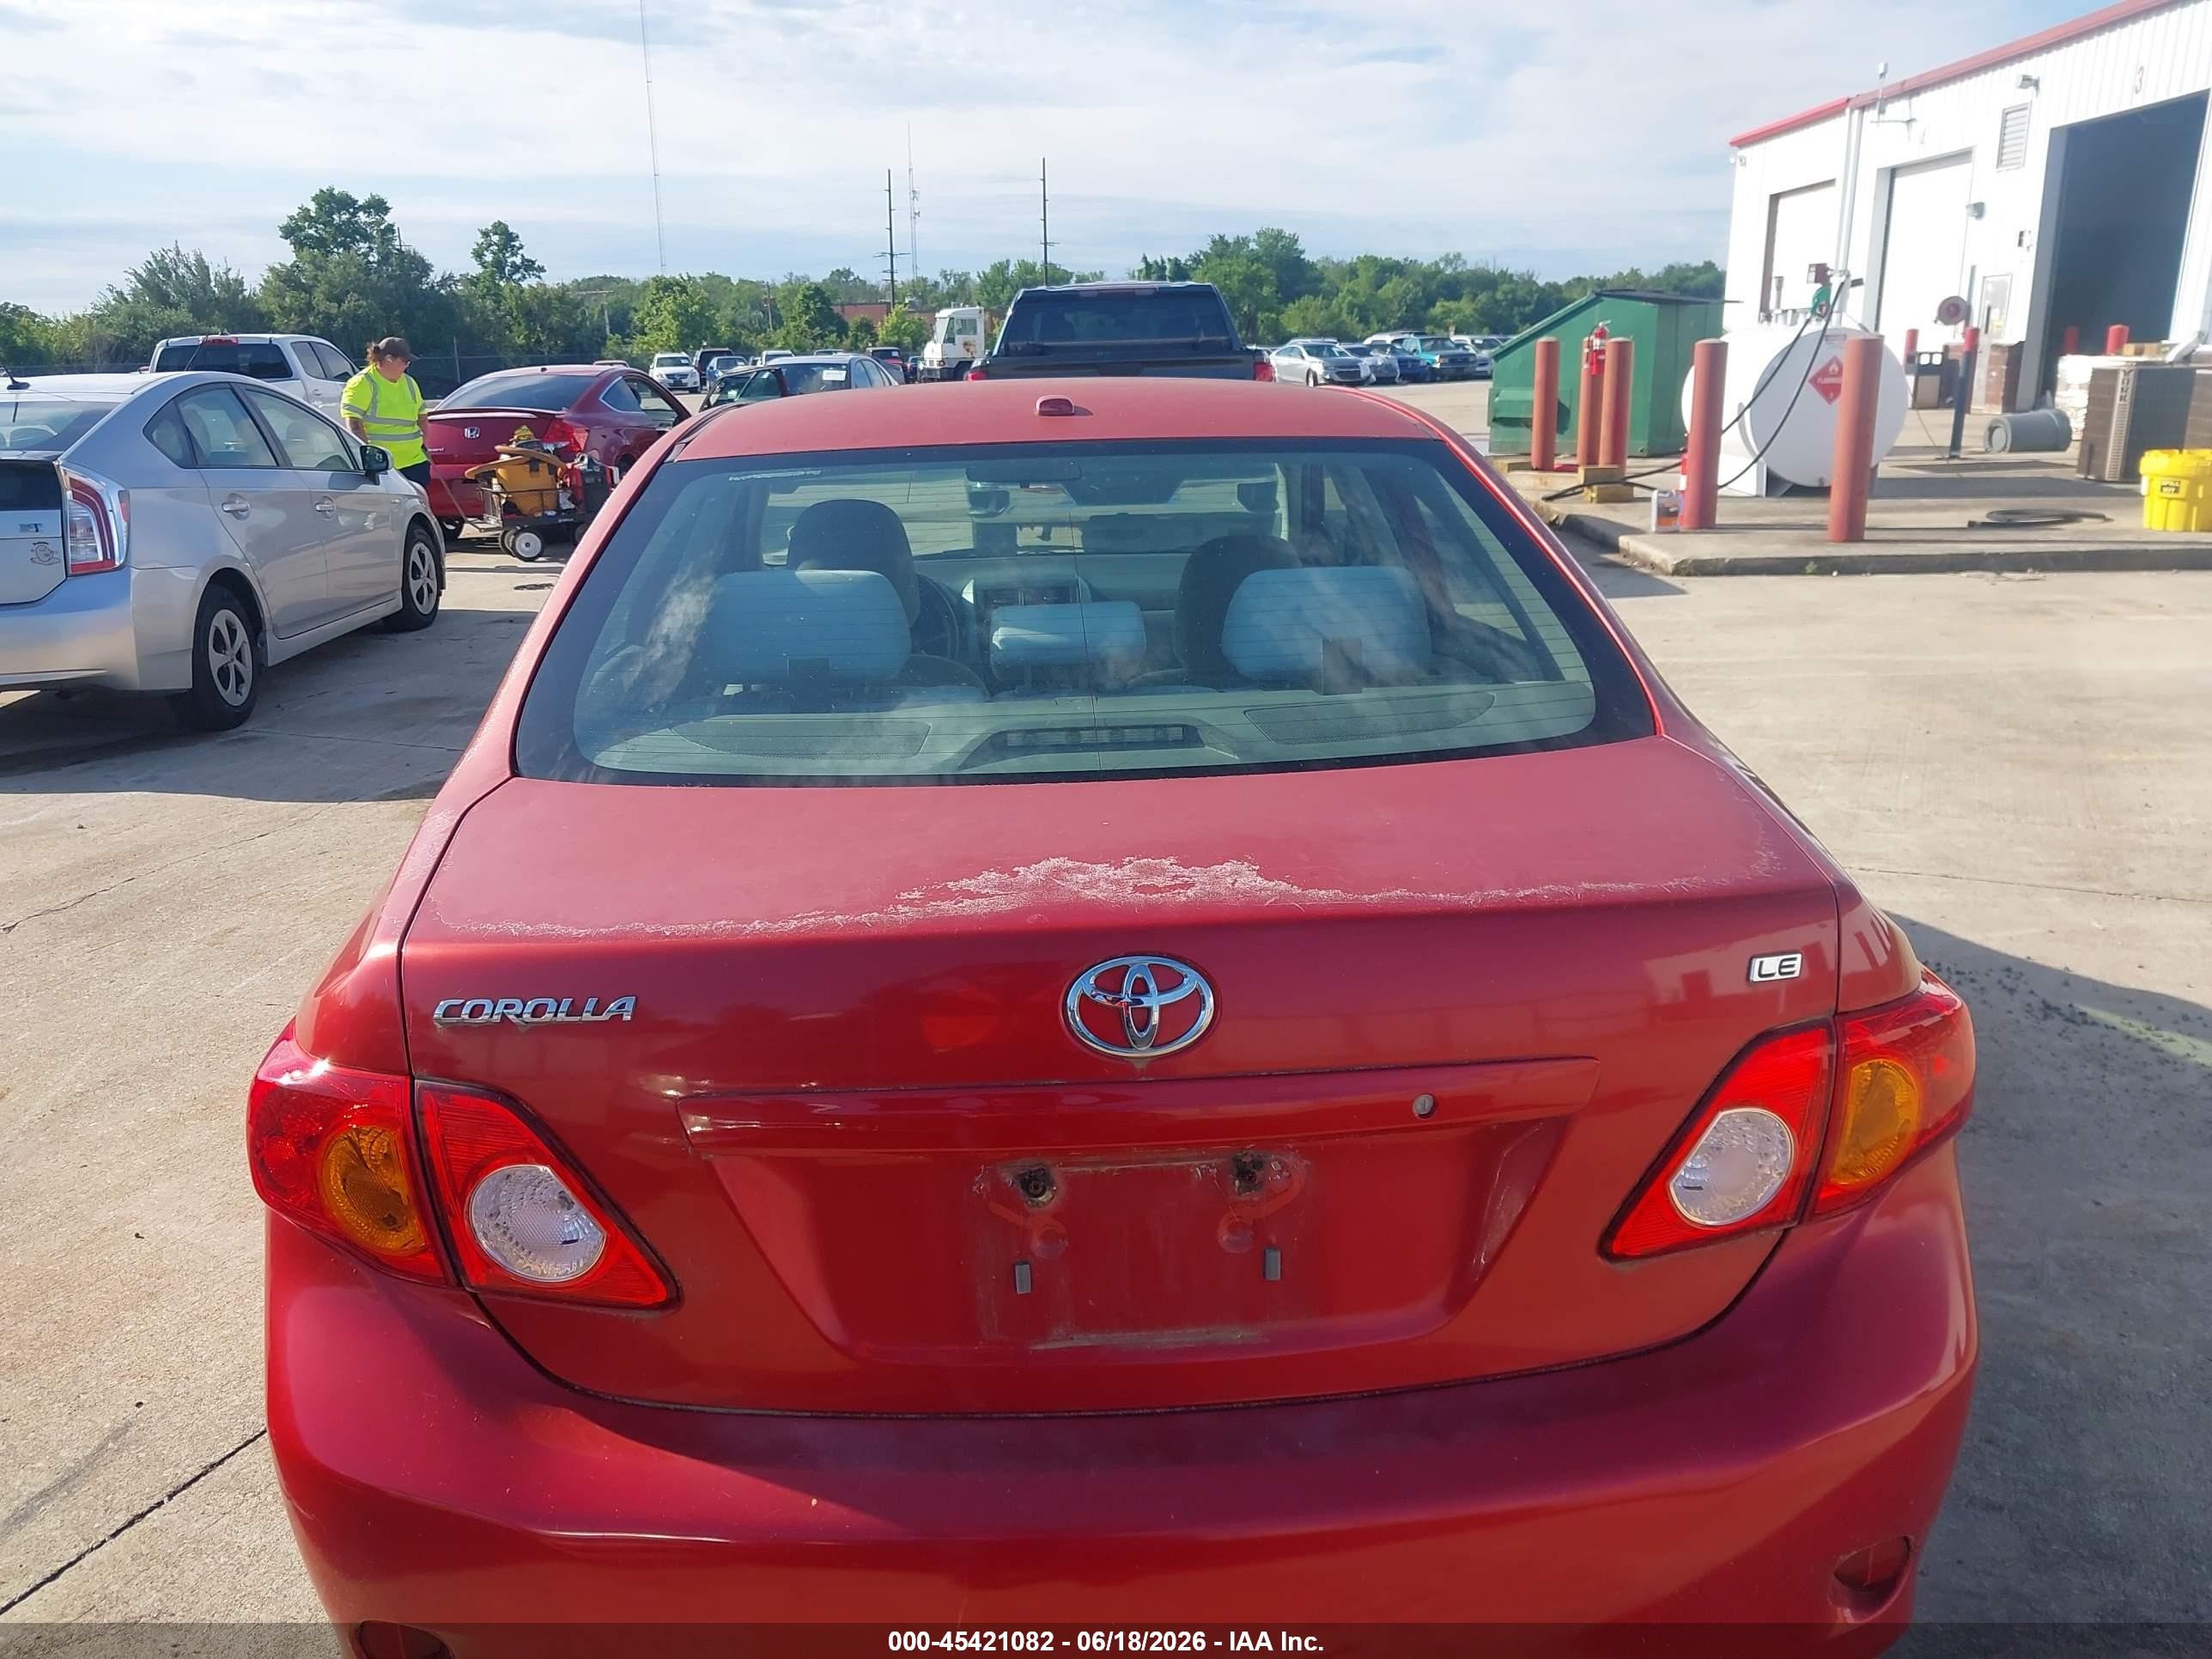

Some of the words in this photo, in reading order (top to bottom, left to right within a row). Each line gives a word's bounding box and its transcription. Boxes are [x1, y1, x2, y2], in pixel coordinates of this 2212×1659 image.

[2135, 65, 2144, 94] 3
[2119, 369, 2134, 403] YORK
[1758, 957, 1798, 978] LE
[433, 996, 636, 1024] COROLLA
